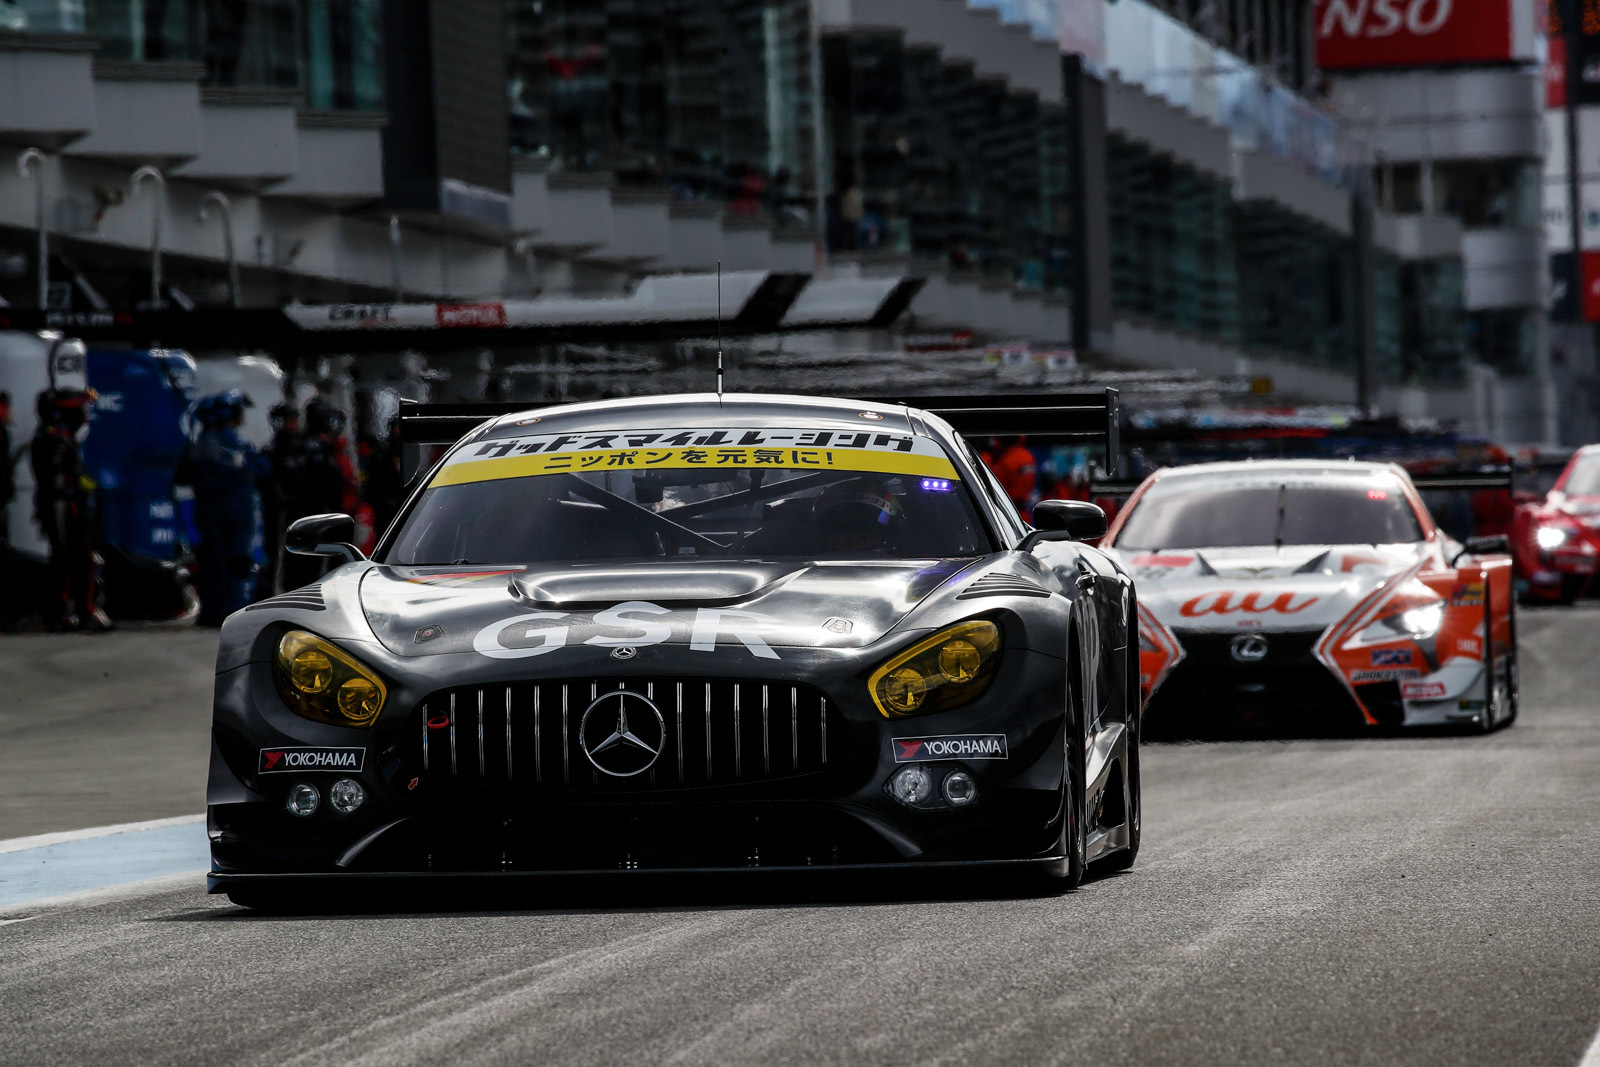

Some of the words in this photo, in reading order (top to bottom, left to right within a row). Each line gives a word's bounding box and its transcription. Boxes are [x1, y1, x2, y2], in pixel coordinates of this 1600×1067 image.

[473, 430, 914, 458] グッドスマイルレーシング
[1178, 590, 1320, 618] au
[472, 601, 782, 660] GSR
[284, 752, 357, 766] YOKOHAMA
[923, 740, 1002, 755] YOKOHAMA
